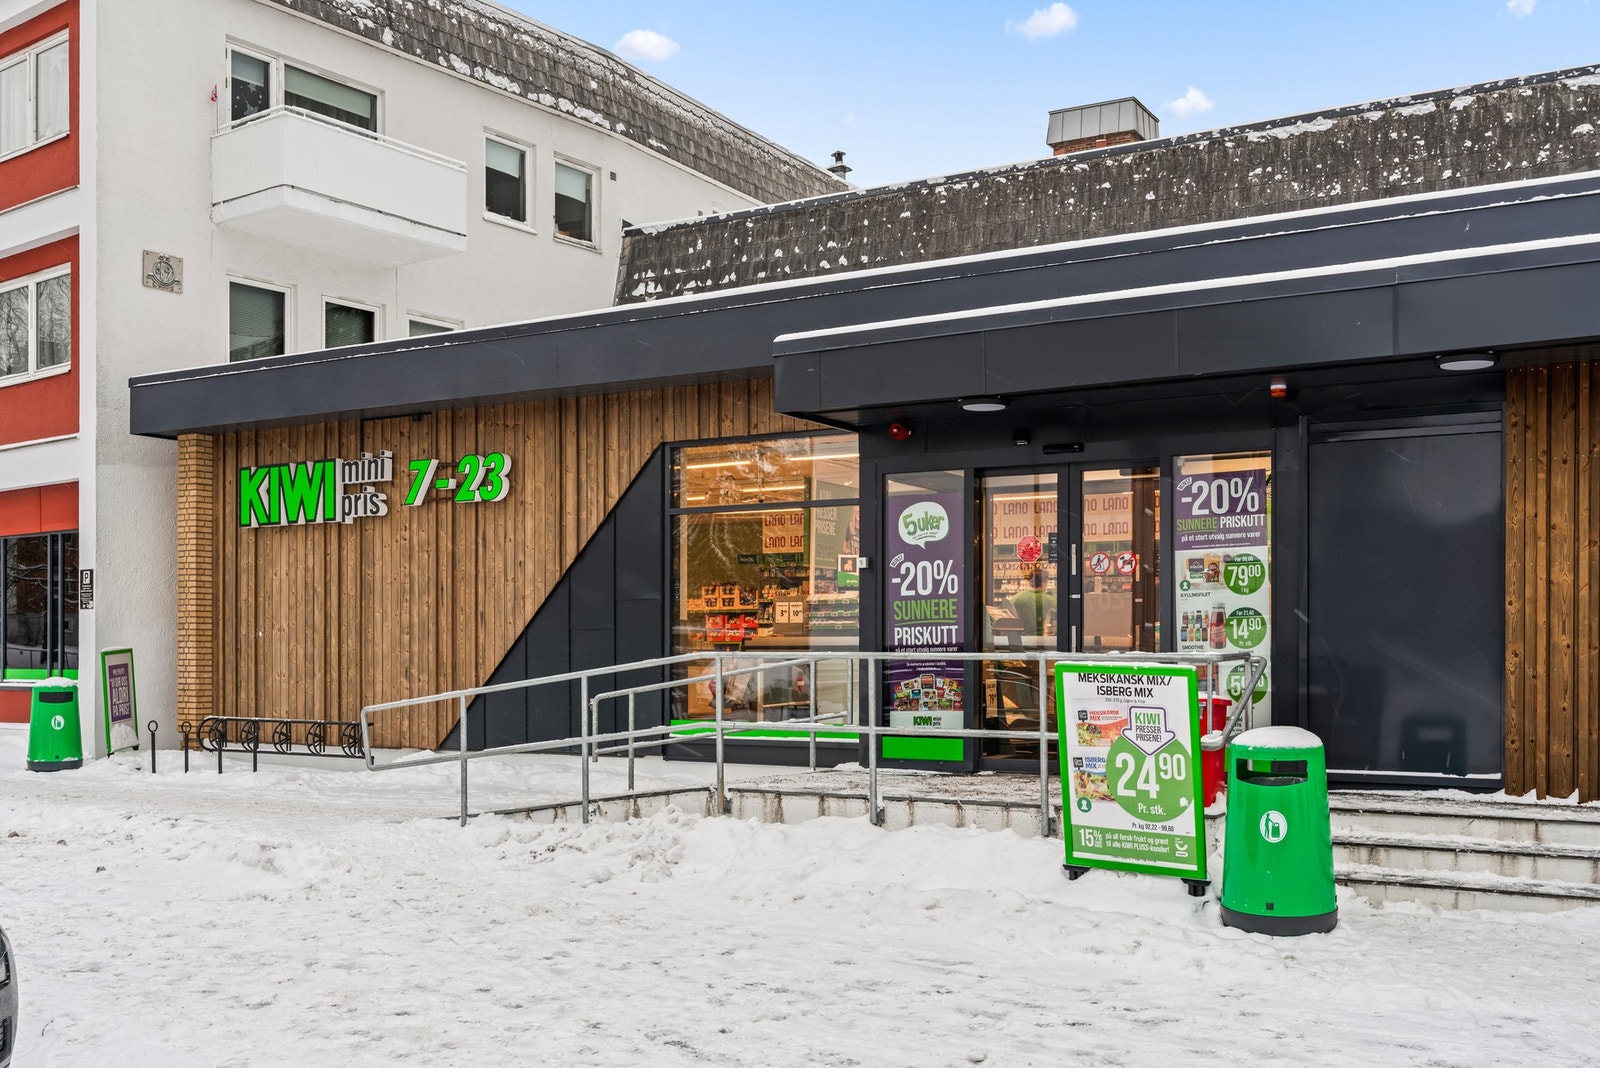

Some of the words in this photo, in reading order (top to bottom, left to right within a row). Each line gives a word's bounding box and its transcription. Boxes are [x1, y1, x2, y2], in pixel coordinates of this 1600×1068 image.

[341, 450, 388, 484] mini
[239, 458, 338, 527] KIWI
[1181, 477, 1260, 515] -20%
[341, 486, 382, 523] pris
[1003, 502, 1028, 515] LANO
[1102, 496, 1129, 511] LANO
[1102, 521, 1129, 535] LANO
[1177, 516, 1218, 531] SUNNERE
[1220, 513, 1266, 529] PRISKUTT
[1181, 535, 1188, 543] på
[1195, 533, 1208, 541] stort
[1208, 532, 1225, 541] utvalg
[891, 559, 958, 596] -20%
[893, 598, 958, 621] SUNNERE
[894, 625, 958, 646] PRISKUTT
[1078, 673, 1145, 685] MEKSIKANSK
[1146, 675, 1173, 686] MIX/
[1096, 685, 1132, 697] ISBERG
[1134, 687, 1154, 698] MIX
[913, 716, 932, 726] KIWI
[1134, 712, 1161, 725] KIWI
[1135, 724, 1162, 734] PRESSER
[1135, 733, 1162, 743] PRISENE!
[1138, 802, 1149, 814] Pr.
[1150, 806, 1167, 816] stk.
[1138, 823, 1145, 831] kg
[1079, 828, 1103, 847] 15%
